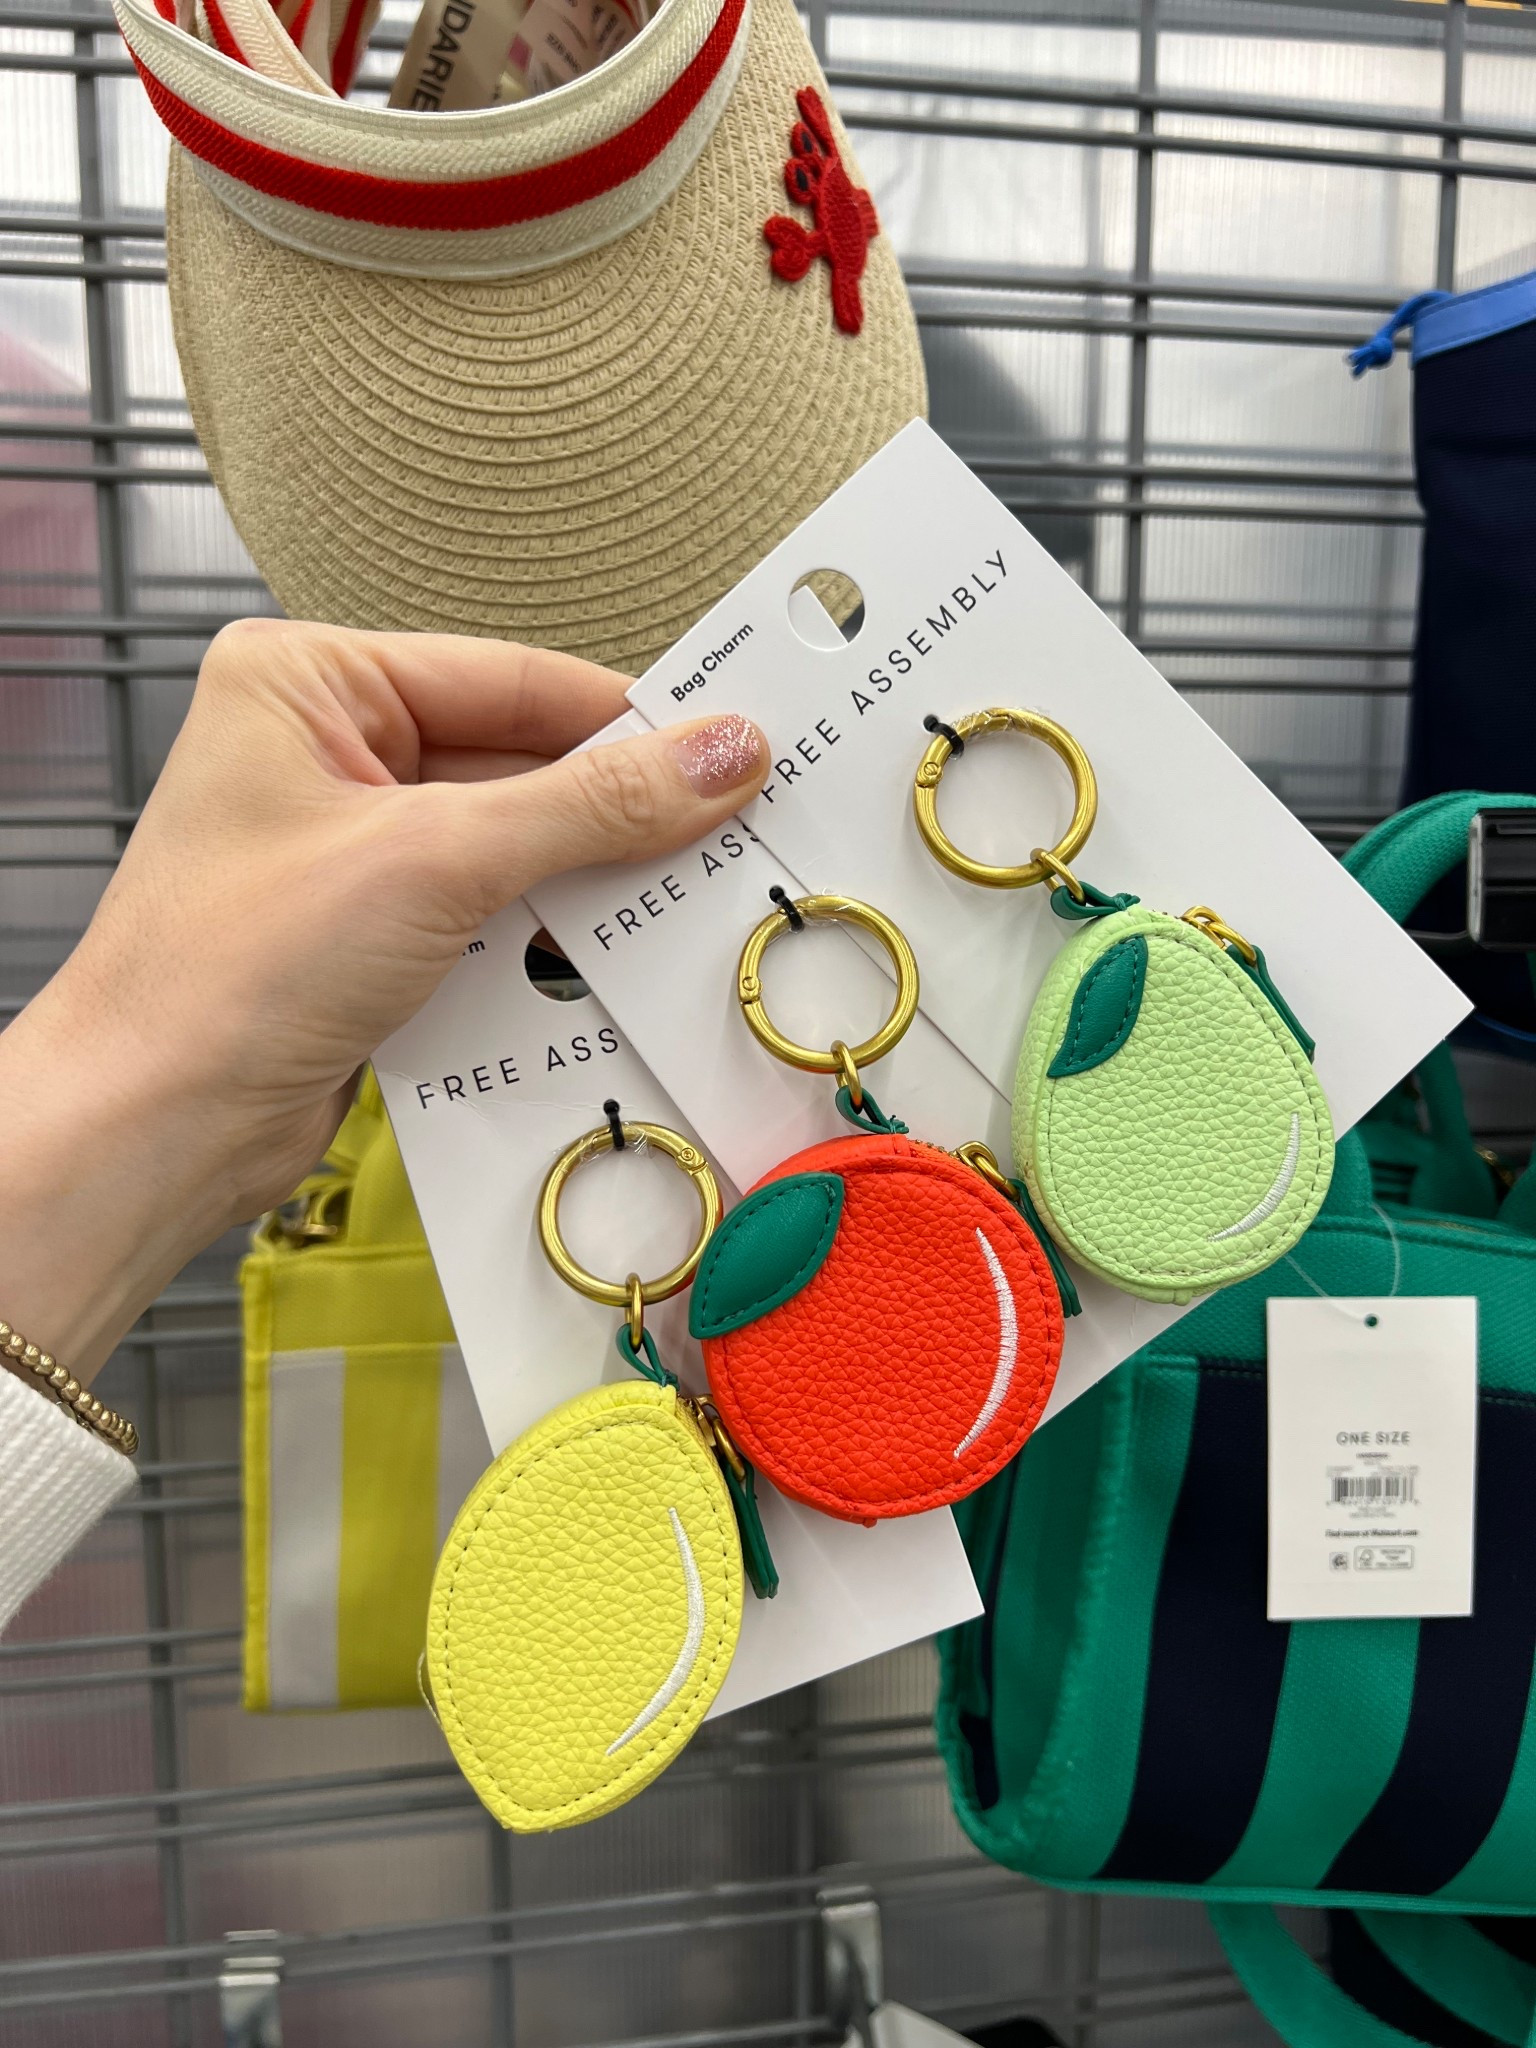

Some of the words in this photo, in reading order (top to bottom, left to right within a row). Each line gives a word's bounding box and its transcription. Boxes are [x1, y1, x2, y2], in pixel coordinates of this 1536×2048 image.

[670, 671, 706, 702] Bag
[701, 624, 754, 672] Charm
[760, 718, 841, 804] FREE
[851, 550, 1008, 716] ASSEMBLY
[592, 874, 686, 951] FREE
[416, 1057, 520, 1110] FREE
[1336, 1431, 1370, 1446] ONE
[1375, 1431, 1411, 1446] SIZE
